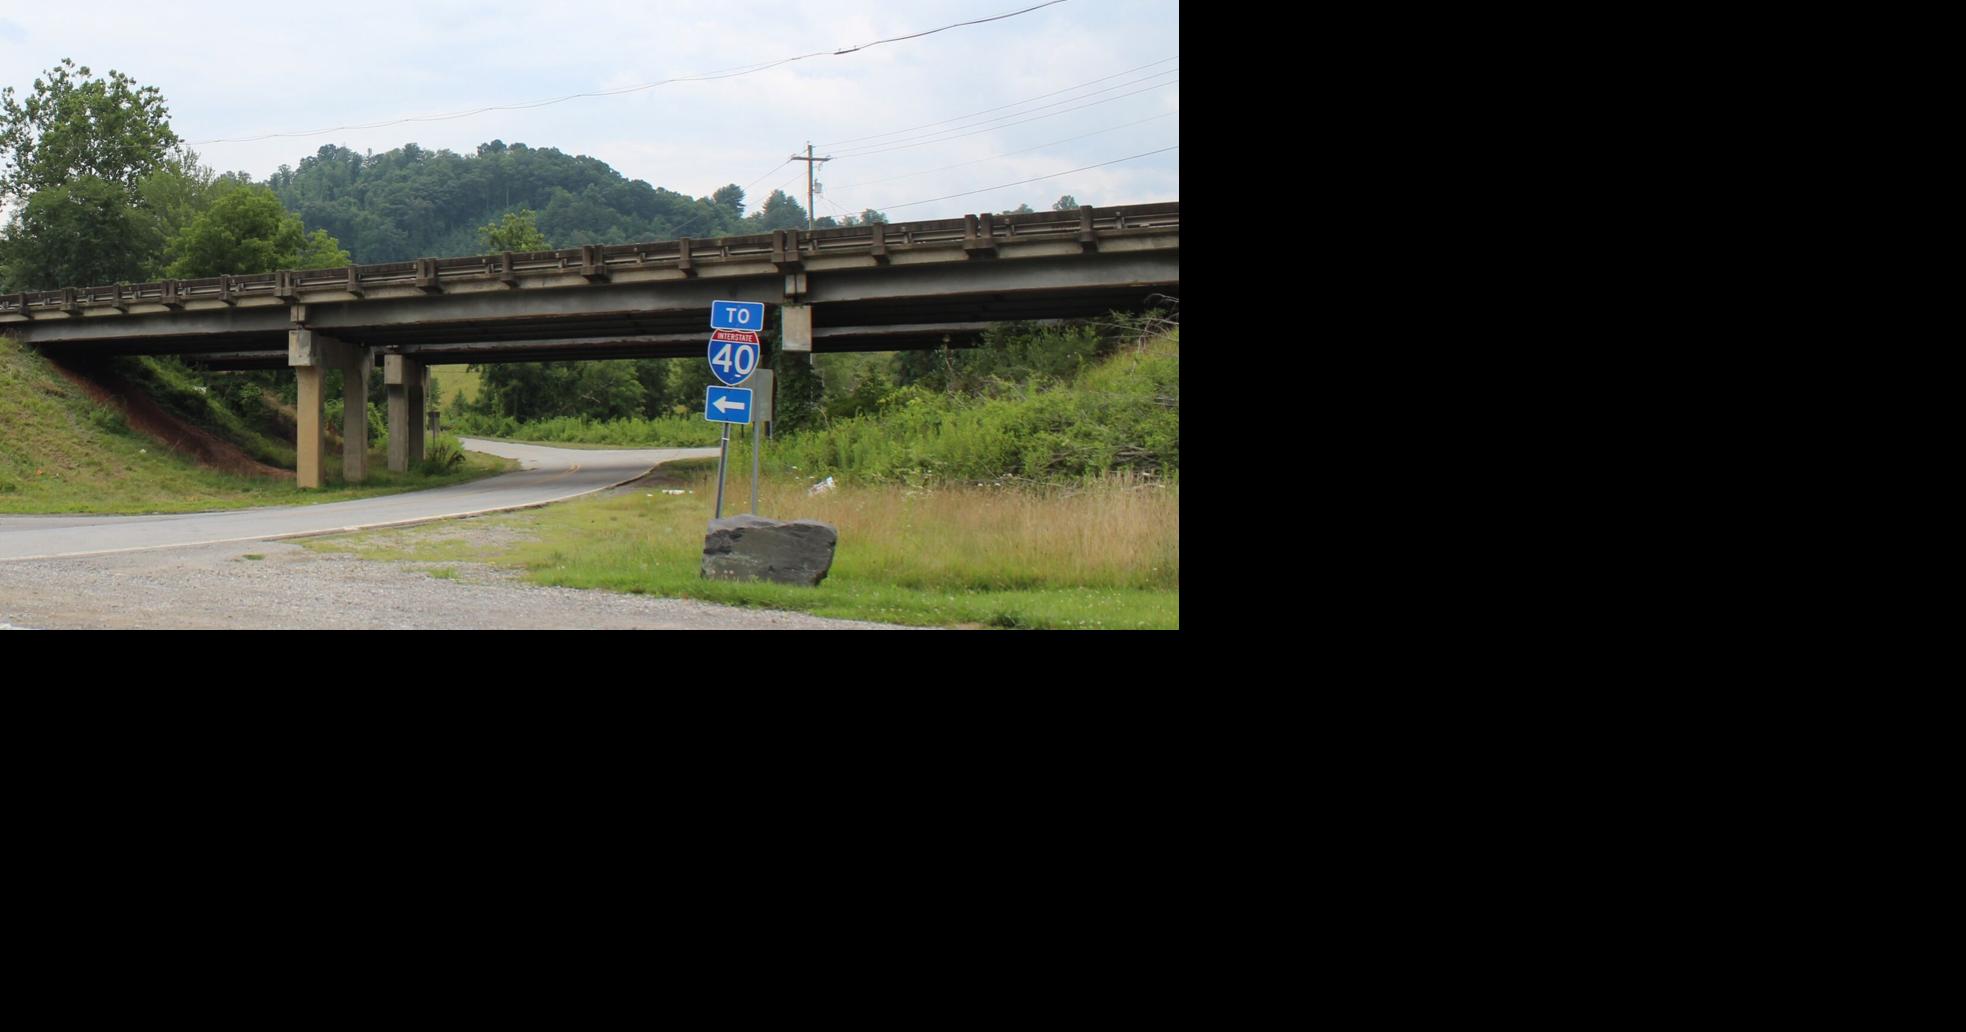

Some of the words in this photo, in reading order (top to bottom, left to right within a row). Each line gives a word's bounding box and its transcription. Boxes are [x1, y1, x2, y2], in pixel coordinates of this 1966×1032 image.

[726, 307, 750, 324] TO
[717, 333, 753, 342] INTERSTATE
[712, 343, 754, 375] 40
